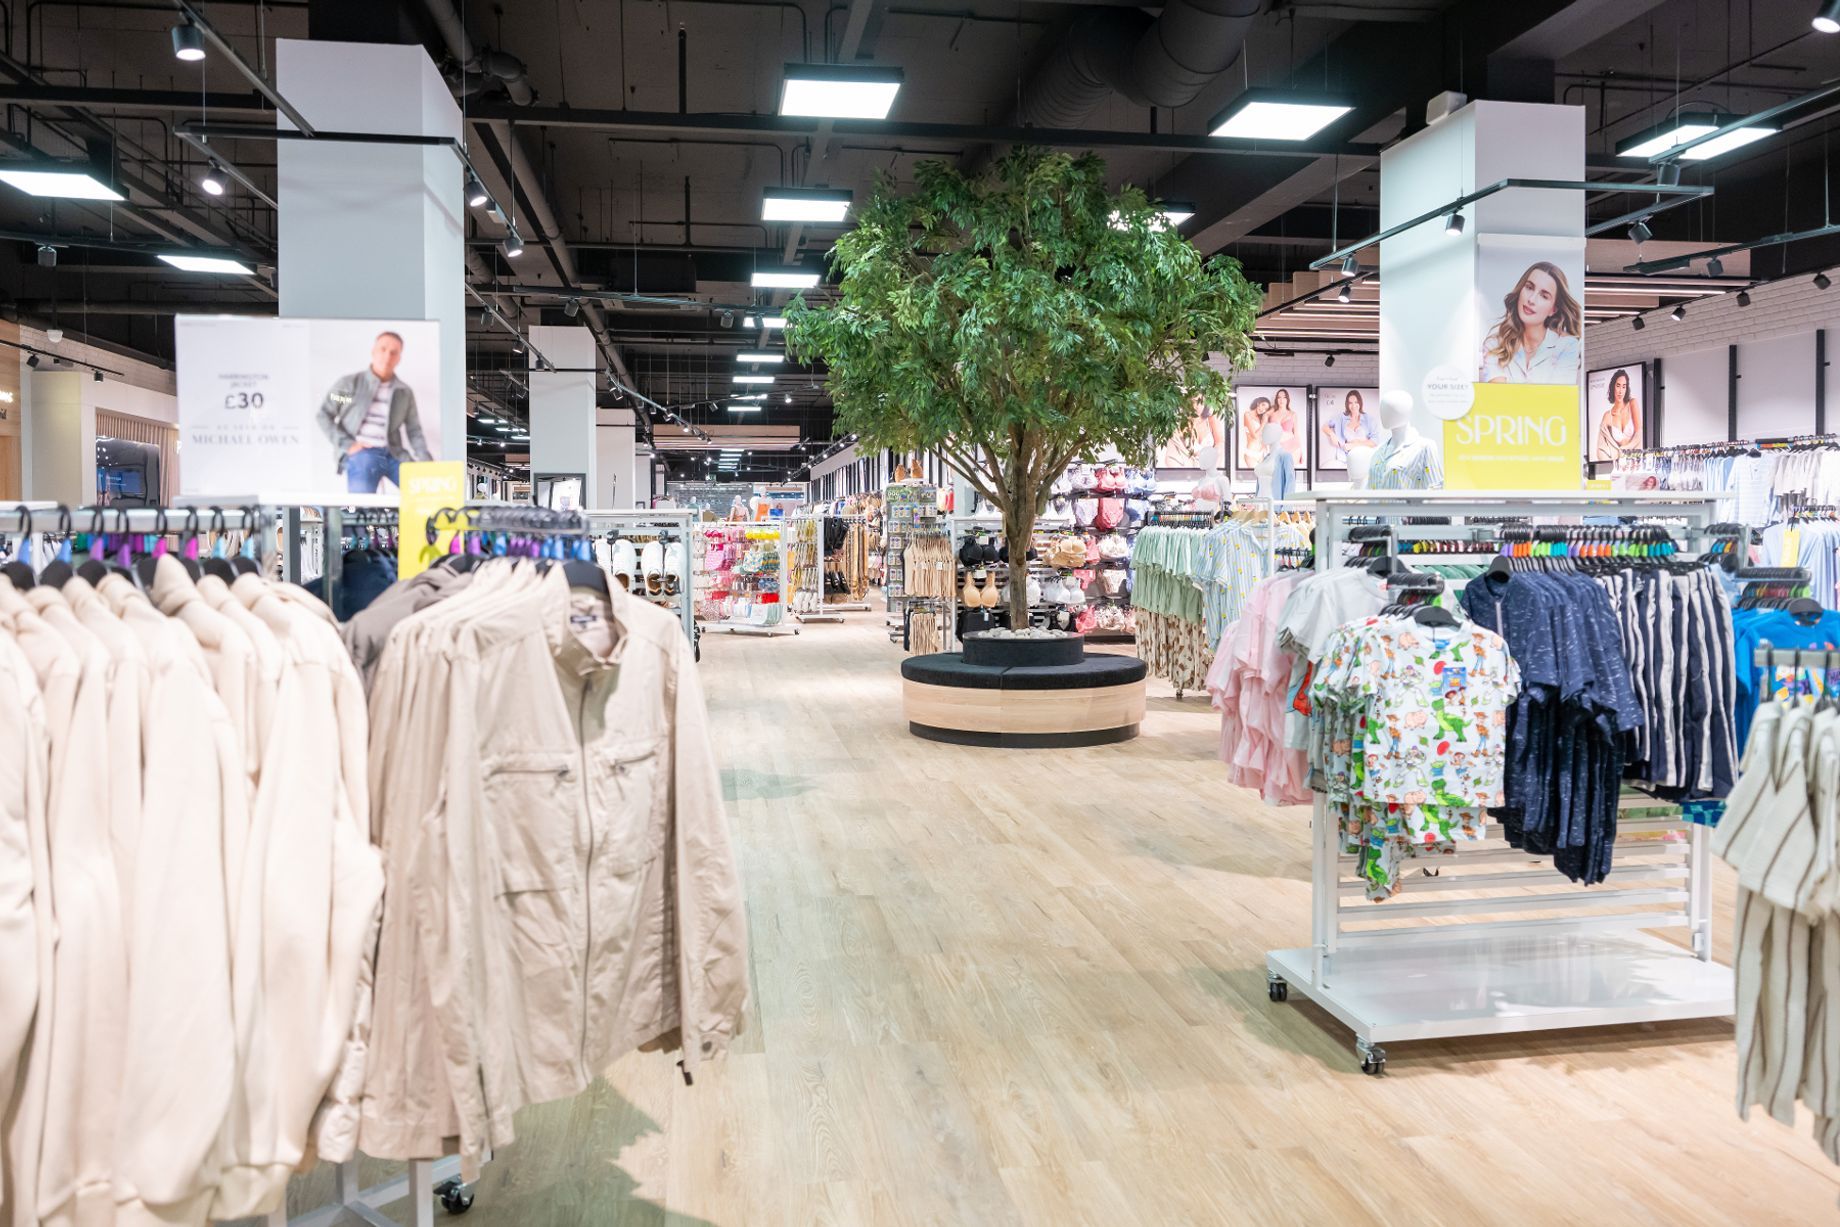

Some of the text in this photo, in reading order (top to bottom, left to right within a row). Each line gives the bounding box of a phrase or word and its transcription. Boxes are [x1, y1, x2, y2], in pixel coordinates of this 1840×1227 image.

[225, 392, 264, 409] £30
[1455, 415, 1568, 446] SPRING
[192, 434, 299, 445] MICHAEL OWEN
